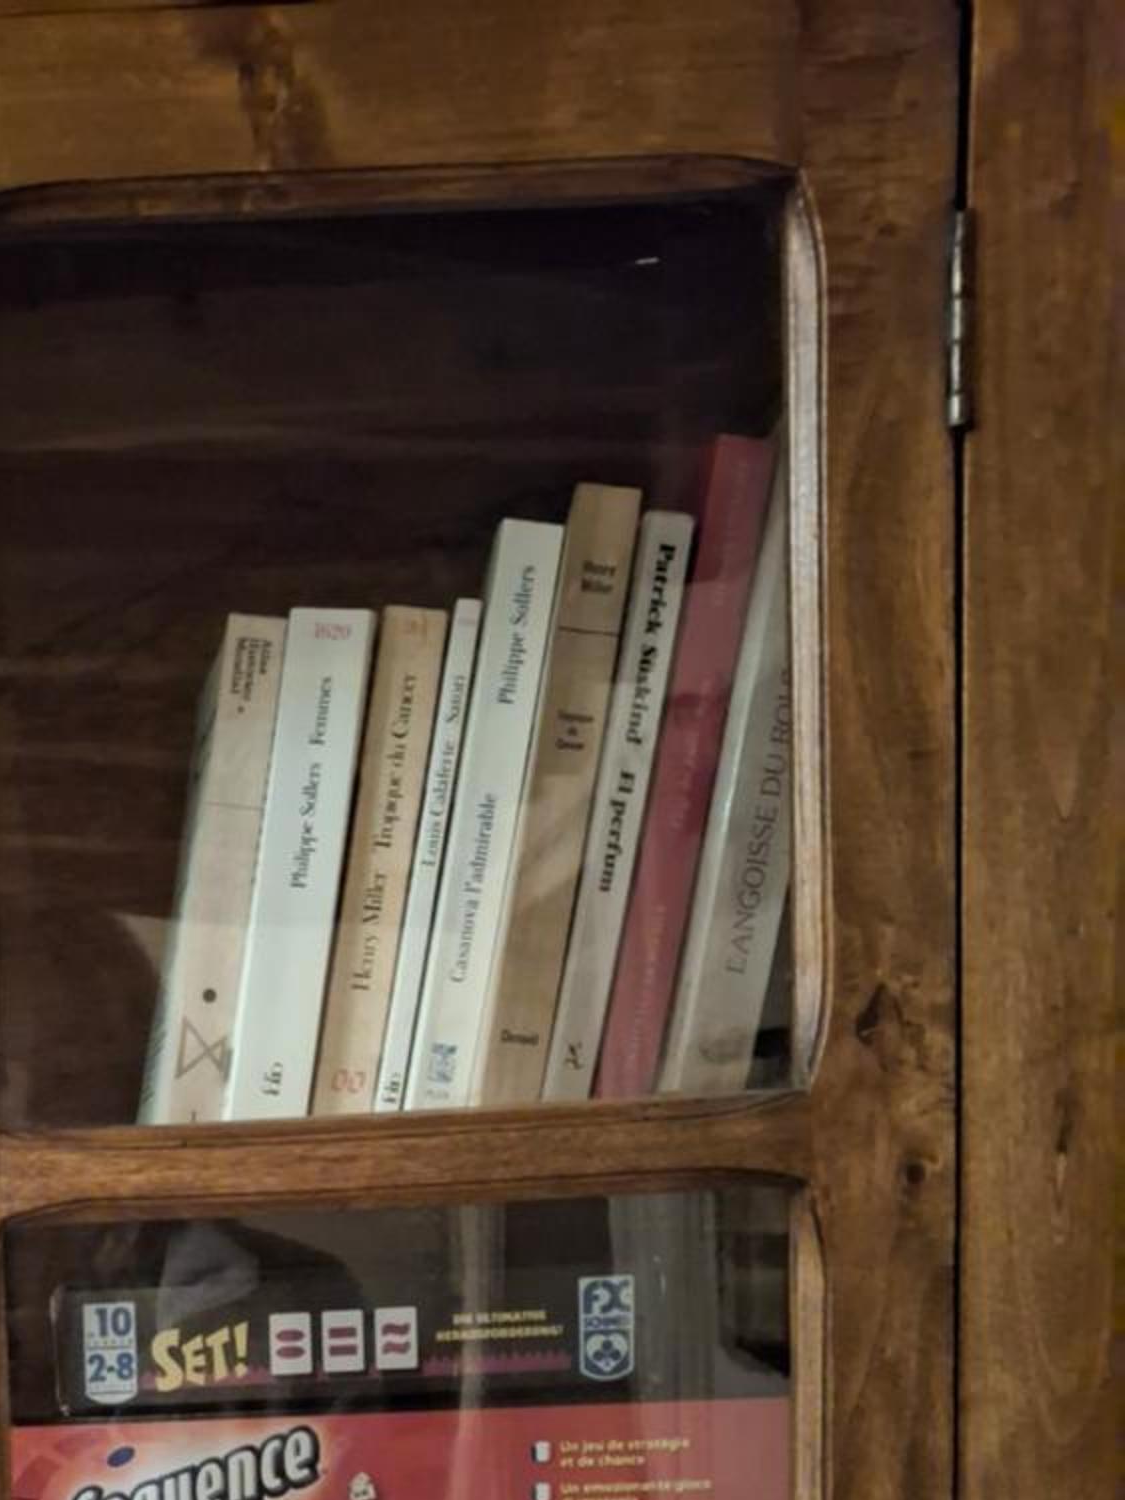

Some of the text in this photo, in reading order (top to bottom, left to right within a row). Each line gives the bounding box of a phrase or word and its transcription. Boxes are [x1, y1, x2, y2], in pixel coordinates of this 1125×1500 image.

[496, 563, 537, 705] Philippe Sollers
[645, 543, 677, 634] Patrick
[289, 675, 333, 889] Philippe Sollers Femmes
[616, 769, 636, 795] El
[350, 672, 420, 991] Henry Miller Tropique du Cancer
[599, 799, 628, 893] perfum
[726, 804, 781, 976] L'ANGOISSE
[760, 757, 787, 799] DU
[449, 899, 481, 984] Casanova
[88, 1352, 135, 1383] 2-8
[94, 1307, 132, 1337] 10
[151, 1320, 249, 1393] SET!
